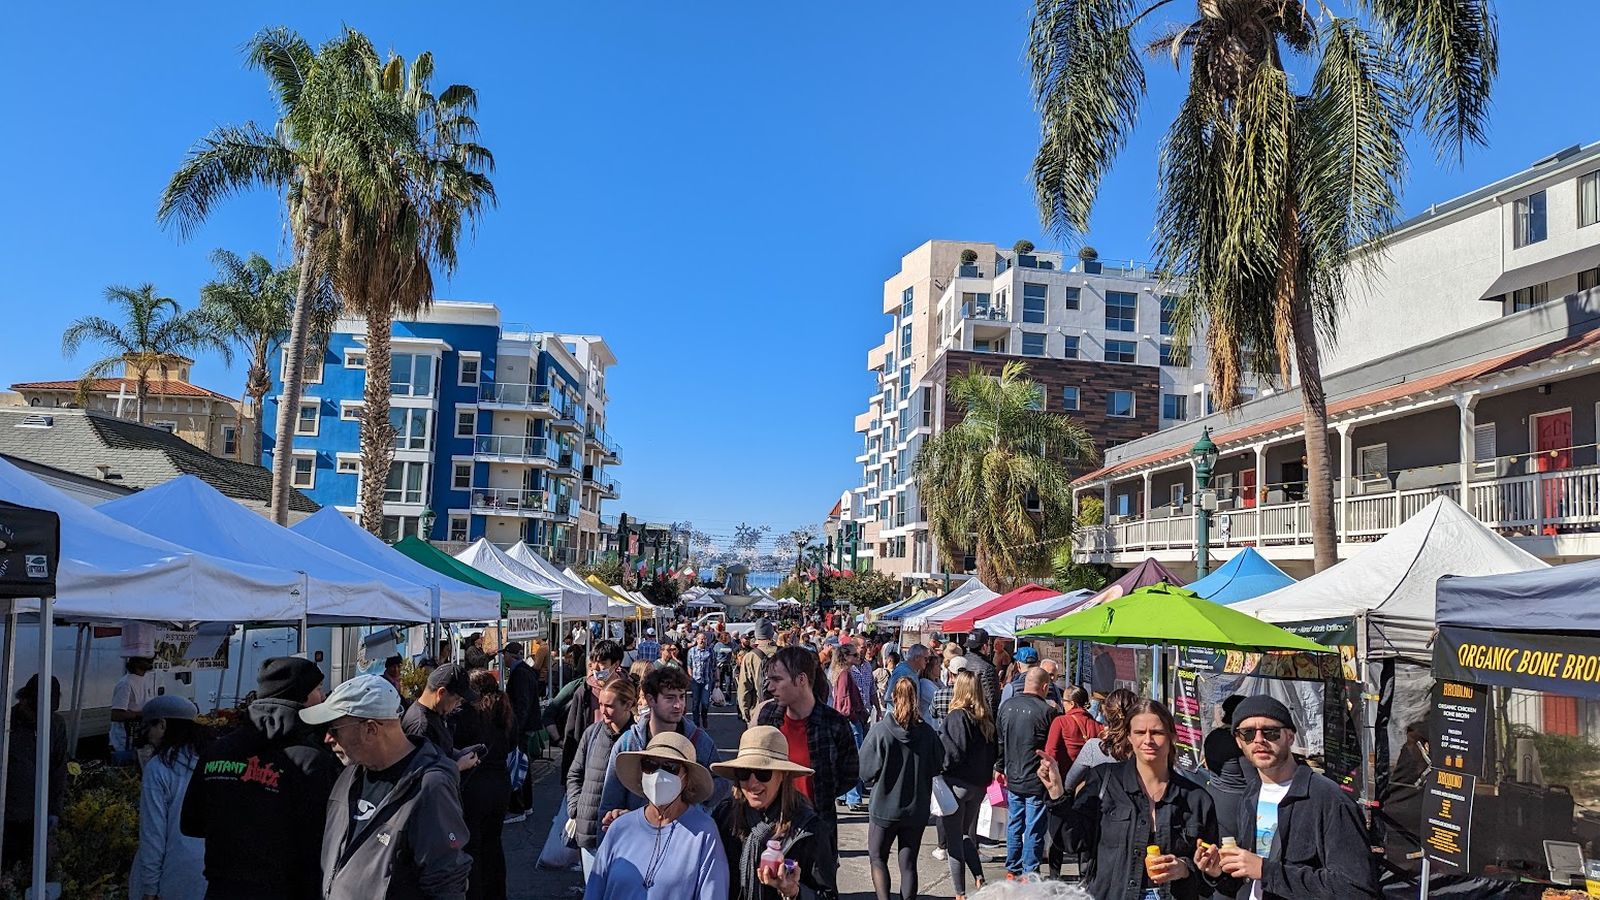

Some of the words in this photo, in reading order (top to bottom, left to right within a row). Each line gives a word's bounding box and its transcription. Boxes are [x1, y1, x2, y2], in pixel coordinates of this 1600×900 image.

[509, 618, 538, 632] ALMONDS
[1458, 643, 1519, 672] ORGANIC
[1516, 650, 1563, 678] BONE
[204, 760, 247, 774] MUTANT
